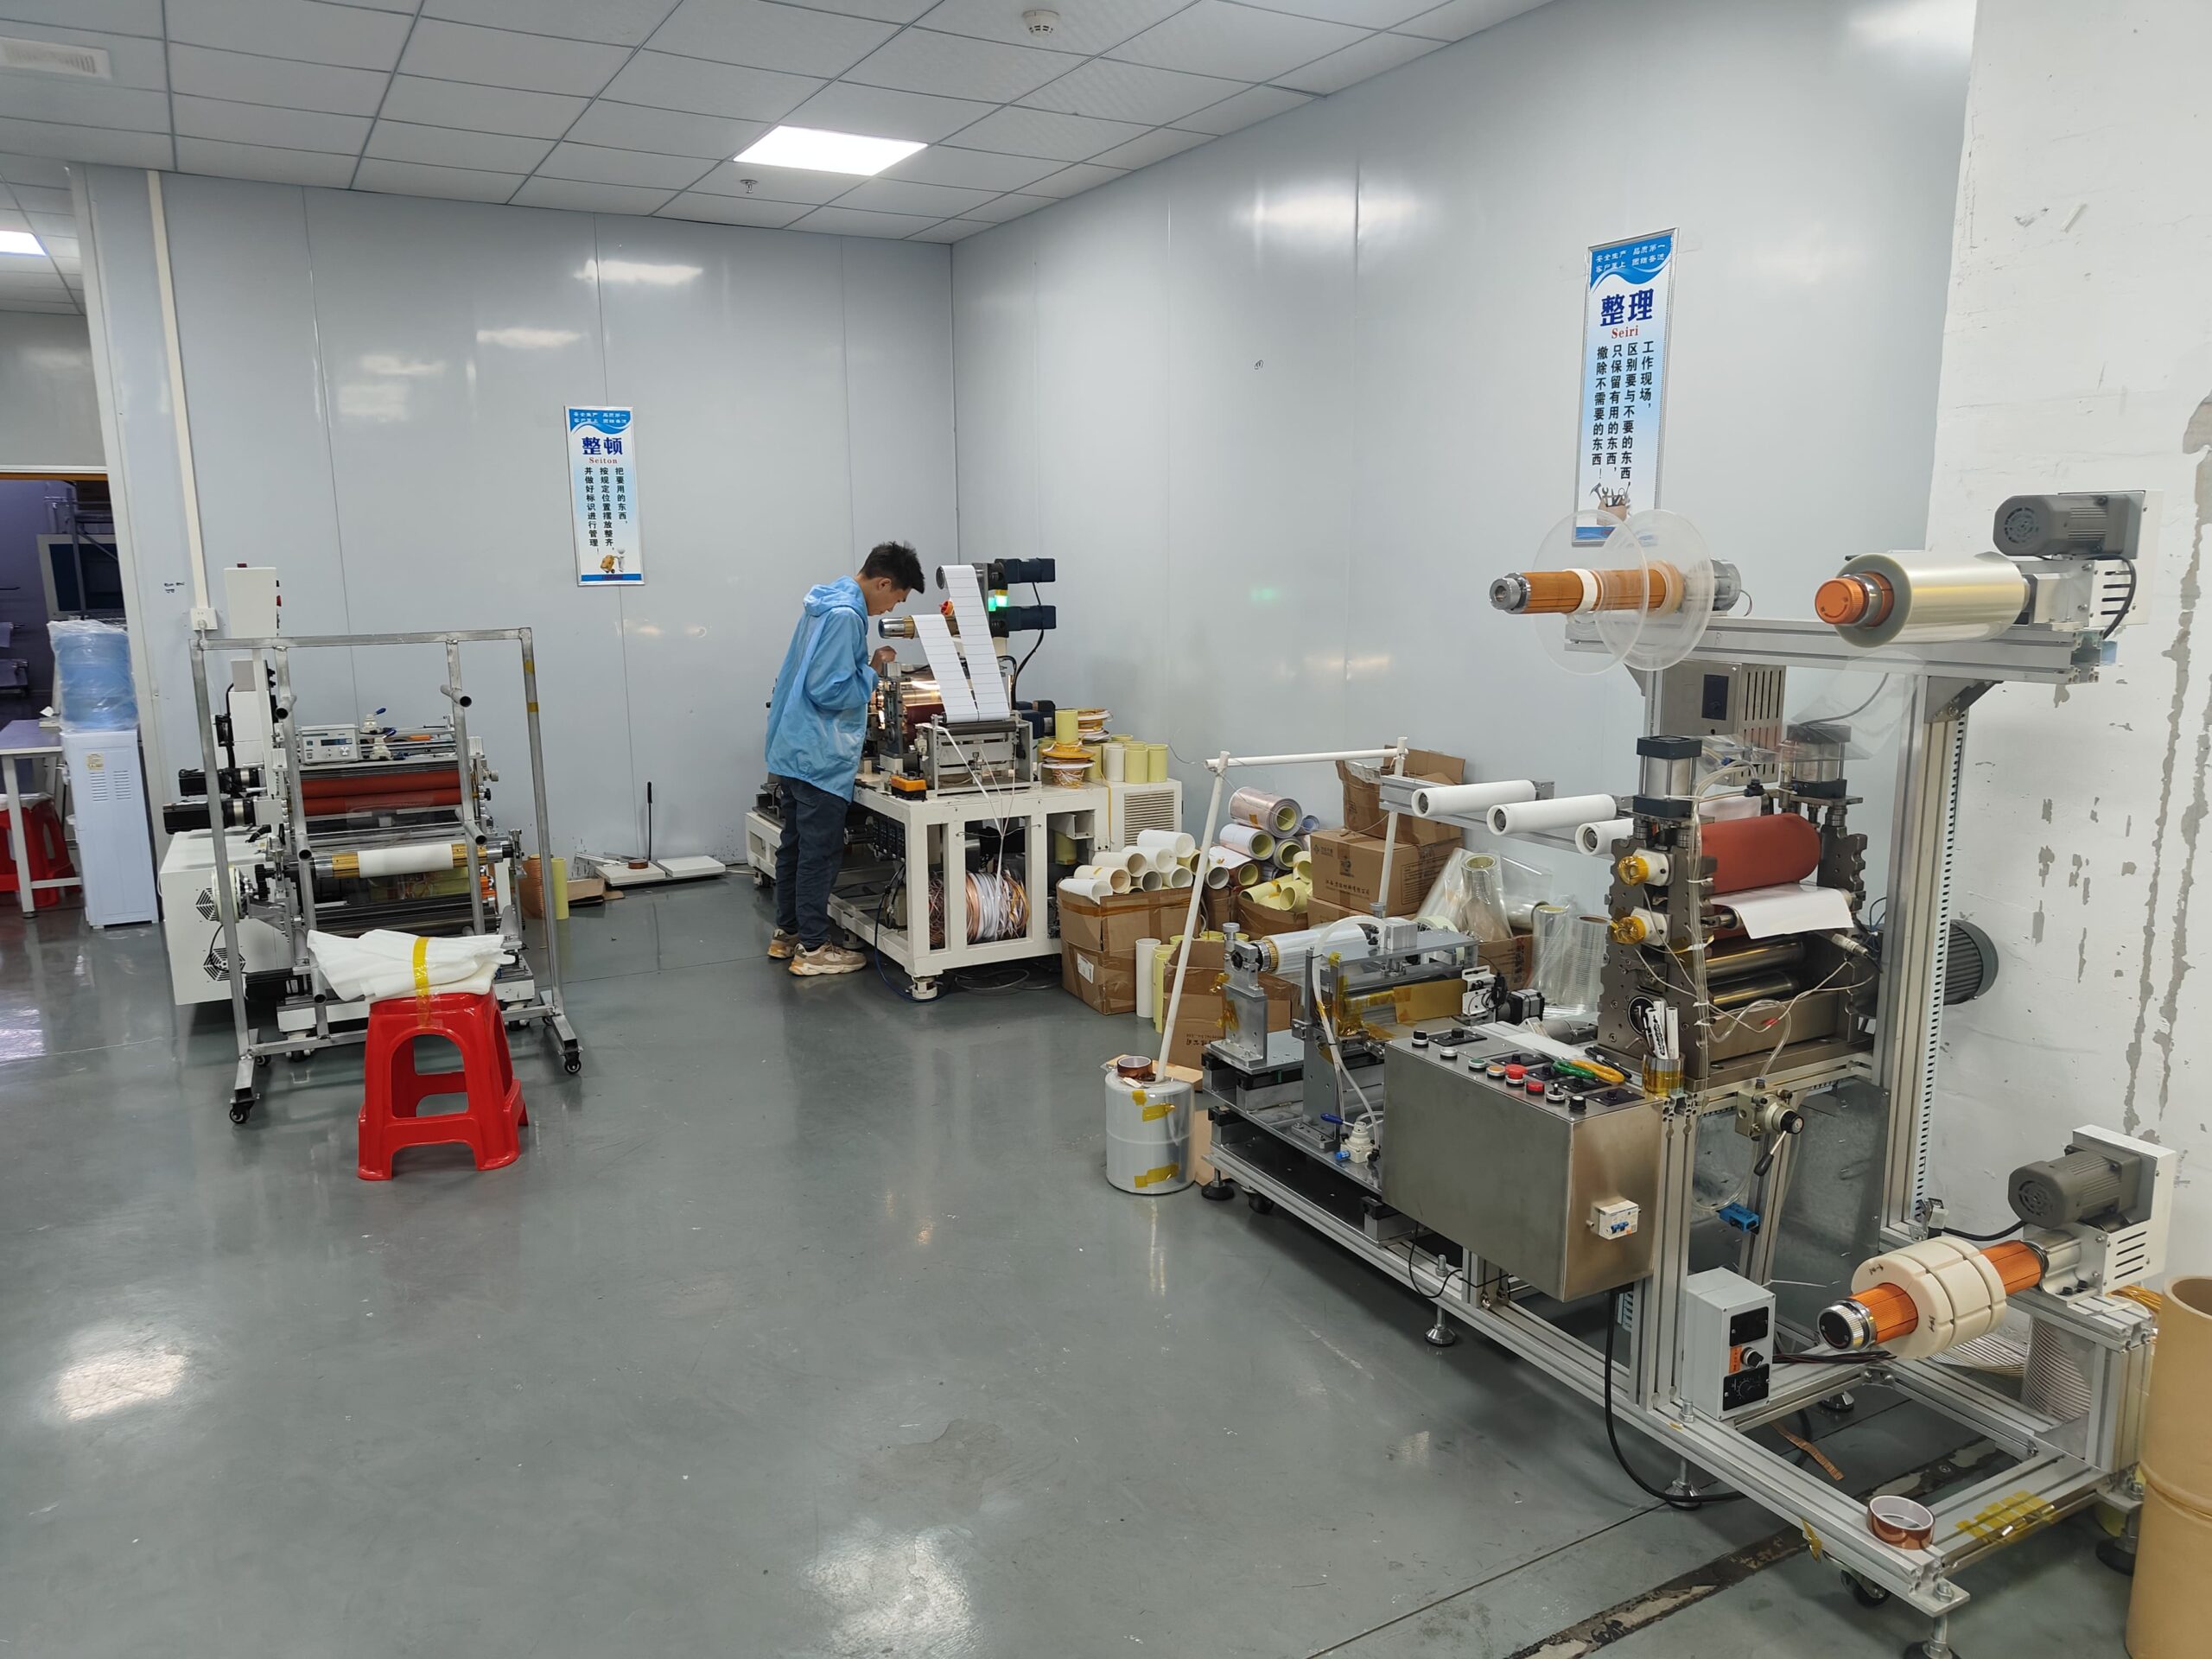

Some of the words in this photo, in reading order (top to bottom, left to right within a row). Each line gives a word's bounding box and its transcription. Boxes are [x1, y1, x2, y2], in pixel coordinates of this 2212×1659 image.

[1600, 288, 1654, 327] 整理
[1611, 325, 1639, 340] Seiri
[581, 436, 623, 455] 整顿
